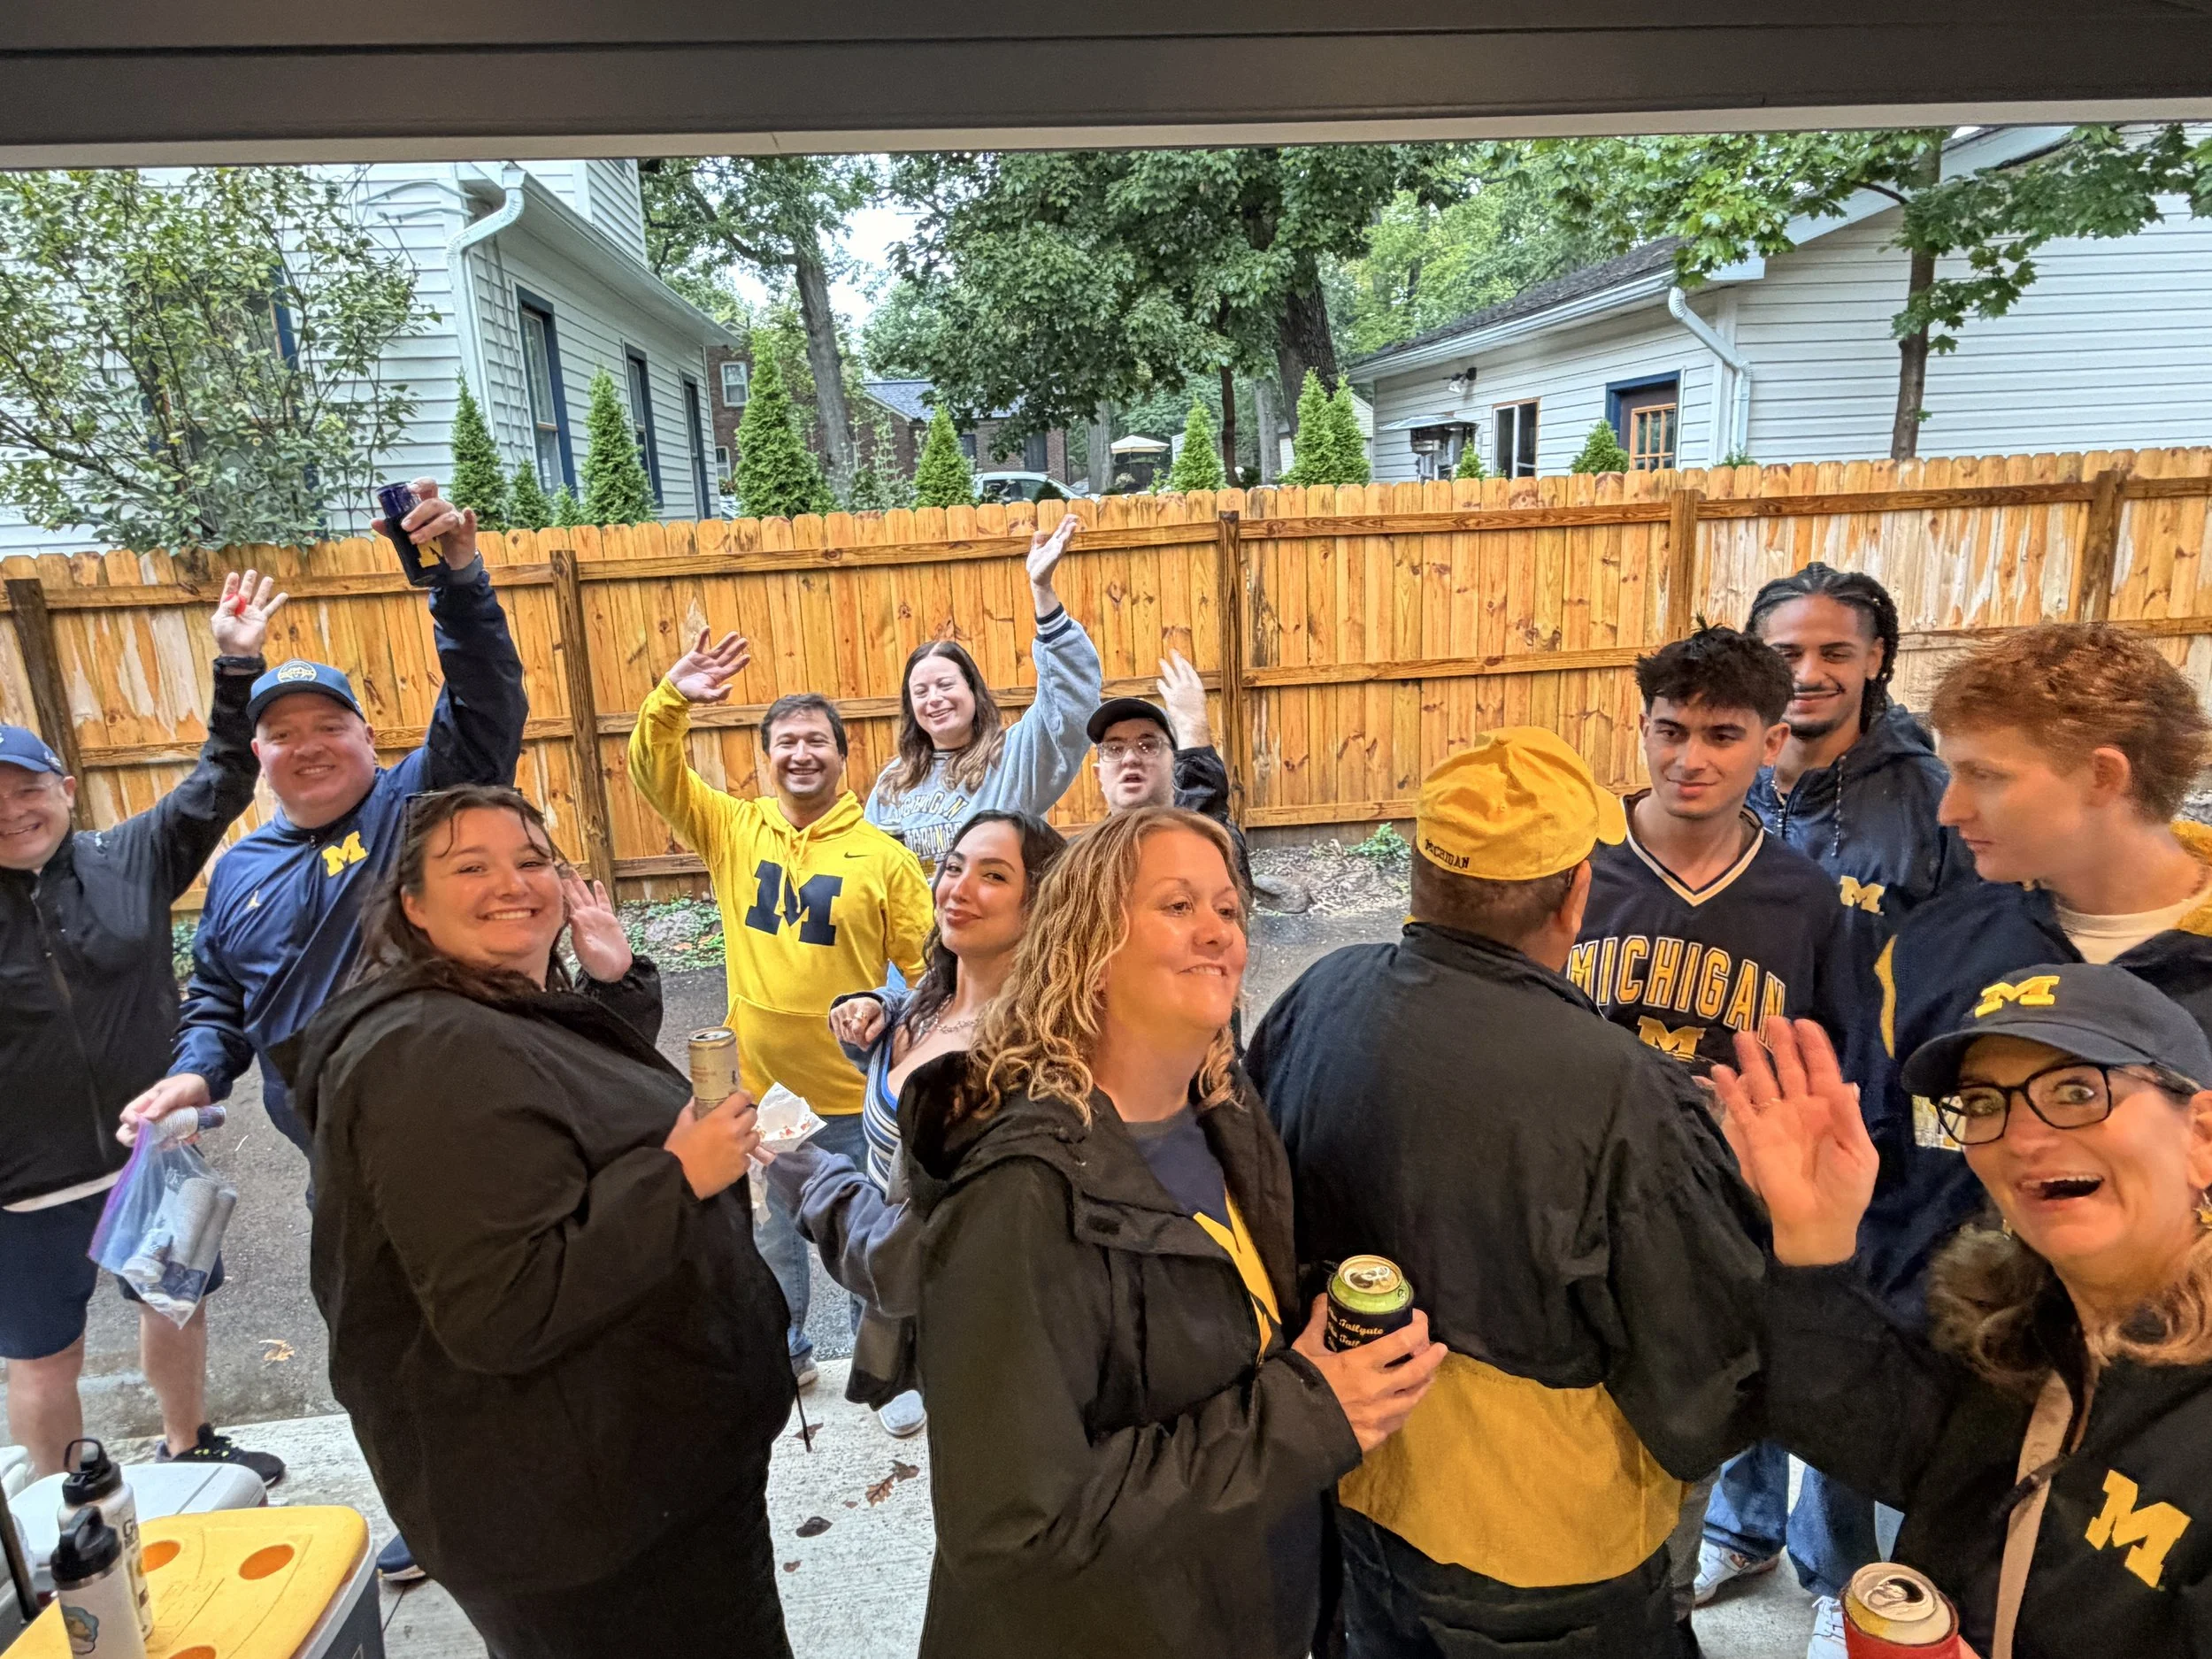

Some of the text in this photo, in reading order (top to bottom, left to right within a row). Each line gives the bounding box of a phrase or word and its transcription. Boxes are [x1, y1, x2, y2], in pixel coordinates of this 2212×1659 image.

[321, 830, 367, 878] M
[745, 858, 843, 946] M
[1839, 874, 1886, 915] M
[1566, 934, 1786, 1053] MICHIGAN
[1974, 975, 2061, 1018] M
[1637, 1015, 1707, 1063] M
[2084, 1469, 2193, 1589] M
